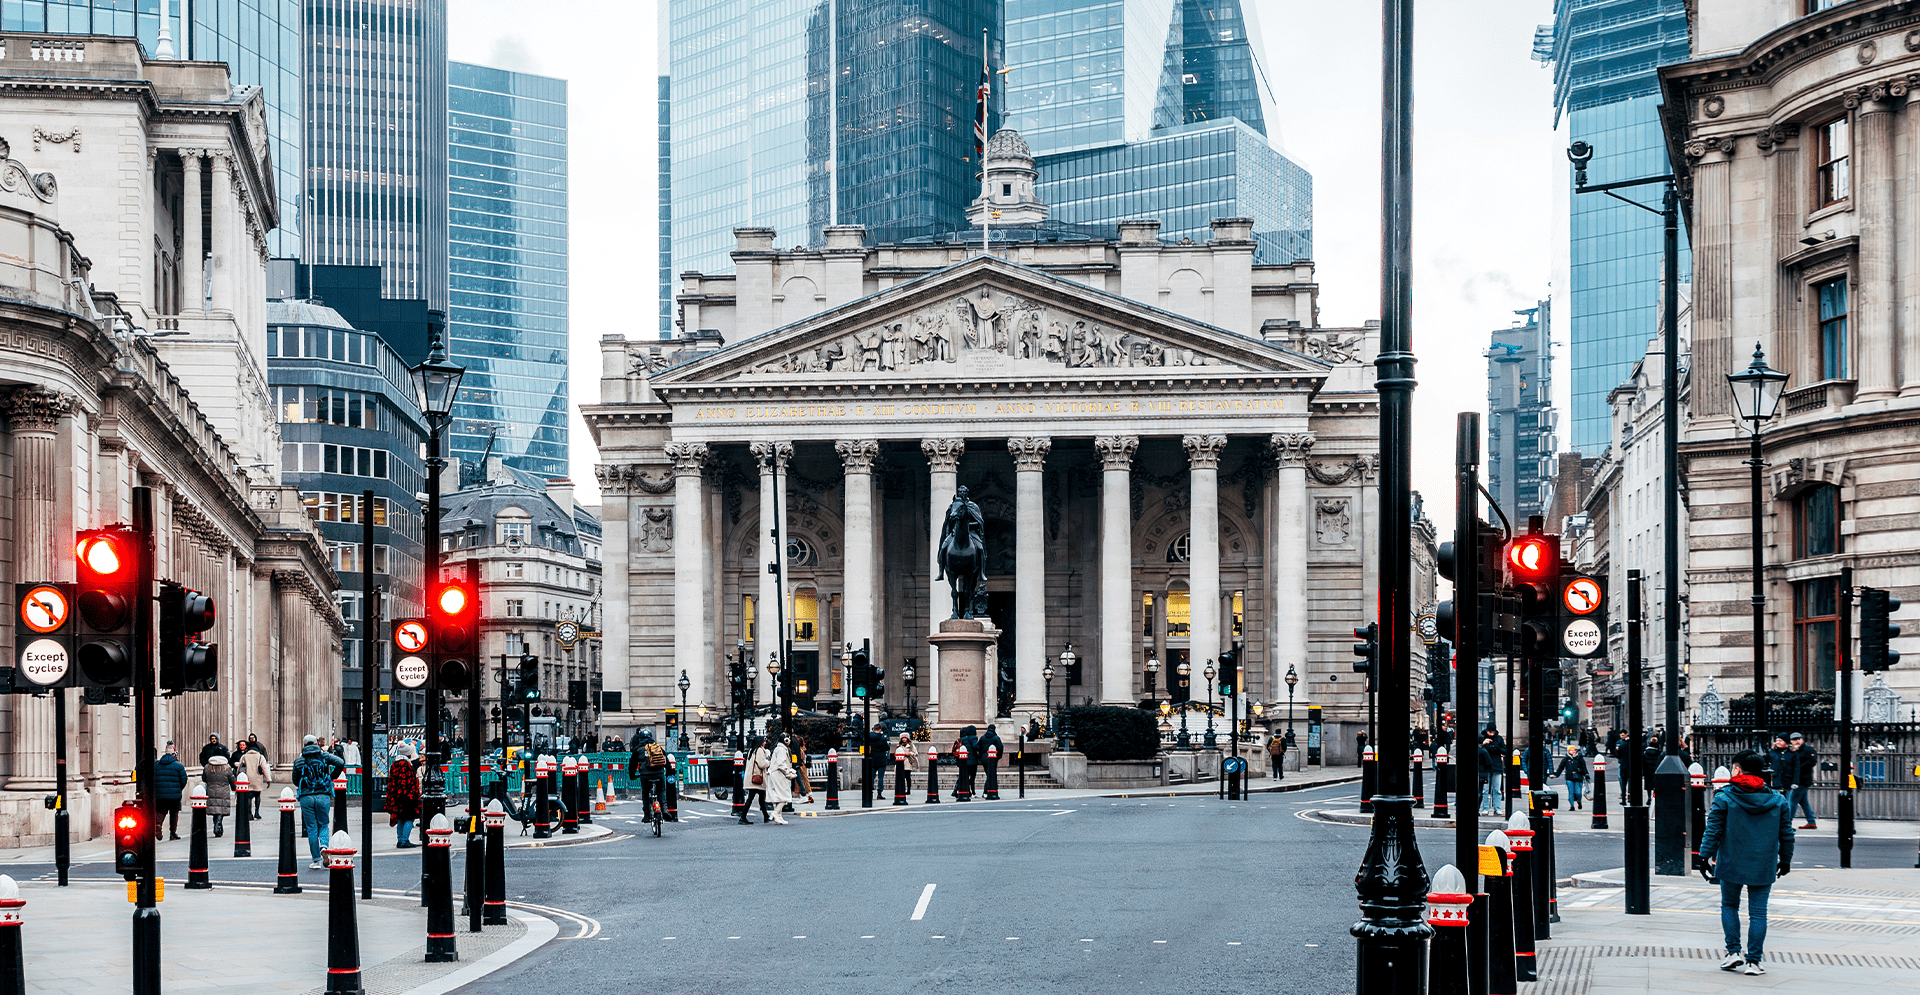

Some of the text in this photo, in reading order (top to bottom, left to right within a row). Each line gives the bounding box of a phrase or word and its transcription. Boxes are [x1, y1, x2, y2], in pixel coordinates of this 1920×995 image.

[695, 398, 1284, 419] ANNO ELIZABETHAE R XIII CONDITVM ANNO VICTORIAE R VIII RESTAVRATVM
[1567, 630, 1598, 638] Except
[1569, 639, 1597, 647] cycles
[26, 652, 65, 662] Except
[28, 663, 63, 674] cycles
[399, 665, 426, 673] Except
[400, 673, 425, 681] cycles
